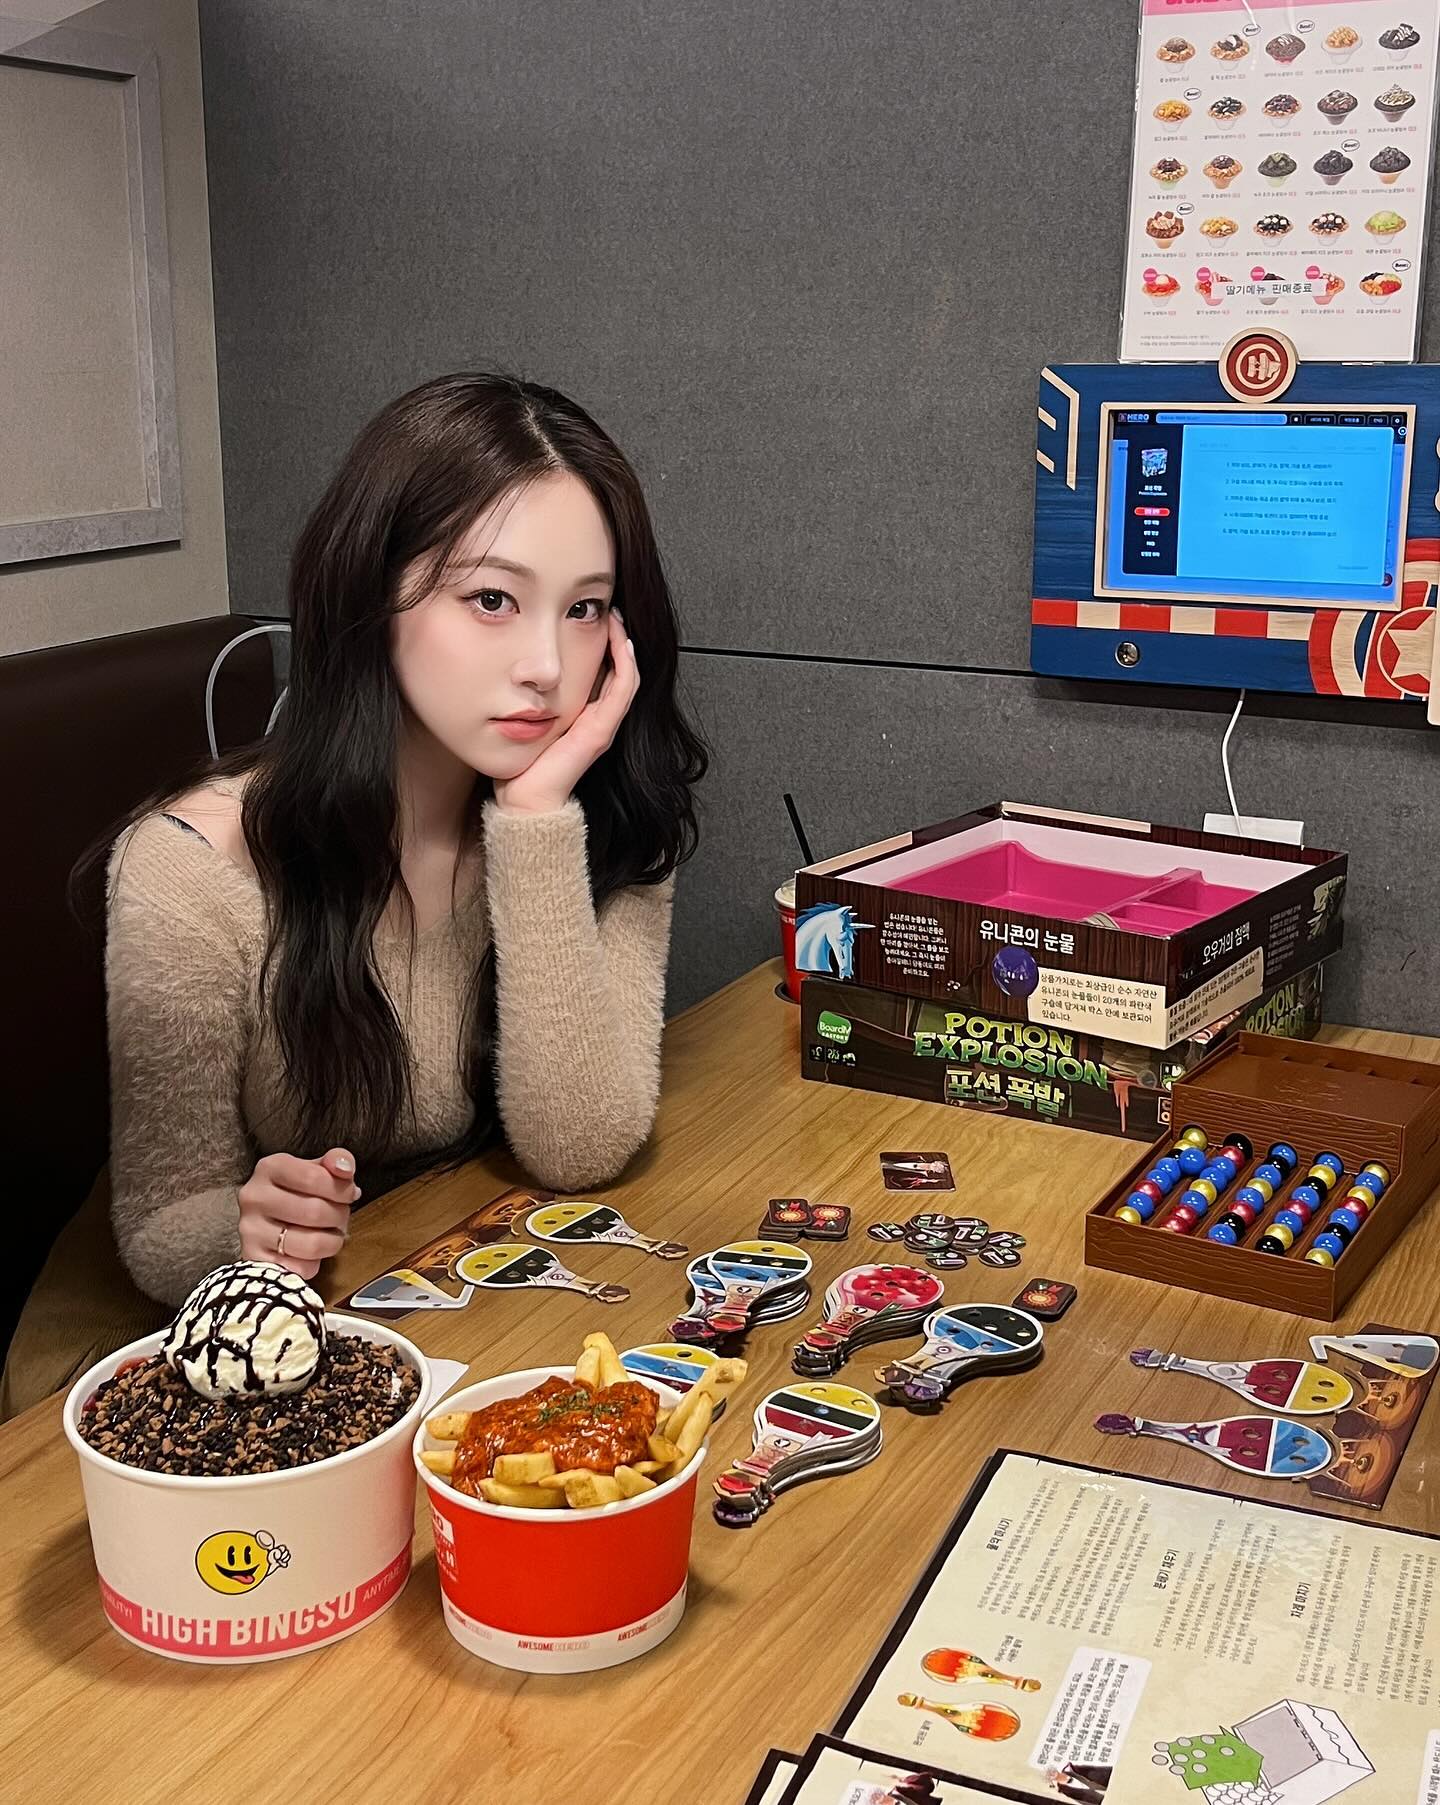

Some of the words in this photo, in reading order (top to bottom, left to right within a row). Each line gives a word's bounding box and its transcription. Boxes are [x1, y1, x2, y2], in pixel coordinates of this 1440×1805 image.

[1226, 283, 1266, 295] 딸기메뉴
[1272, 282, 1312, 295] 판매종료
[1127, 413, 1149, 422] HERO
[979, 920, 1039, 949] 유니콘의
[1043, 930, 1075, 955] 눈물
[1202, 930, 1234, 966] 오우거의
[1041, 973, 1084, 988] 상품가치로는
[1085, 980, 1115, 993] 최상급인
[1117, 985, 1132, 994] 순수
[1134, 988, 1158, 1000] 자연산
[1041, 985, 1069, 998] 유니콘의
[1071, 991, 1101, 1003] 눈물들이
[1102, 996, 1127, 1007] 20개의
[1129, 1000, 1152, 1011] 파란색
[1041, 998, 1063, 1009] 구슬에
[1088, 1006, 1103, 1015] 박스
[1105, 1008, 1120, 1018] 안에
[1122, 1012, 1152, 1023] 보관되어
[1042, 1009, 1072, 1023] 있습니다.
[1246, 983, 1296, 1034] POTION
[944, 1012, 1074, 1057] POTION
[913, 1031, 1110, 1090] EXPLOSION
[946, 1069, 1002, 1103] 포션
[1005, 1076, 1065, 1118] 폭발
[986, 1535, 1003, 1551] 물약
[999, 1518, 1013, 1540] 마시기
[1161, 1549, 1180, 1569] 채우기
[1153, 1570, 1171, 1590] 분배기
[141, 1606, 218, 1646] HIGH
[229, 1586, 357, 1646] BINGSU
